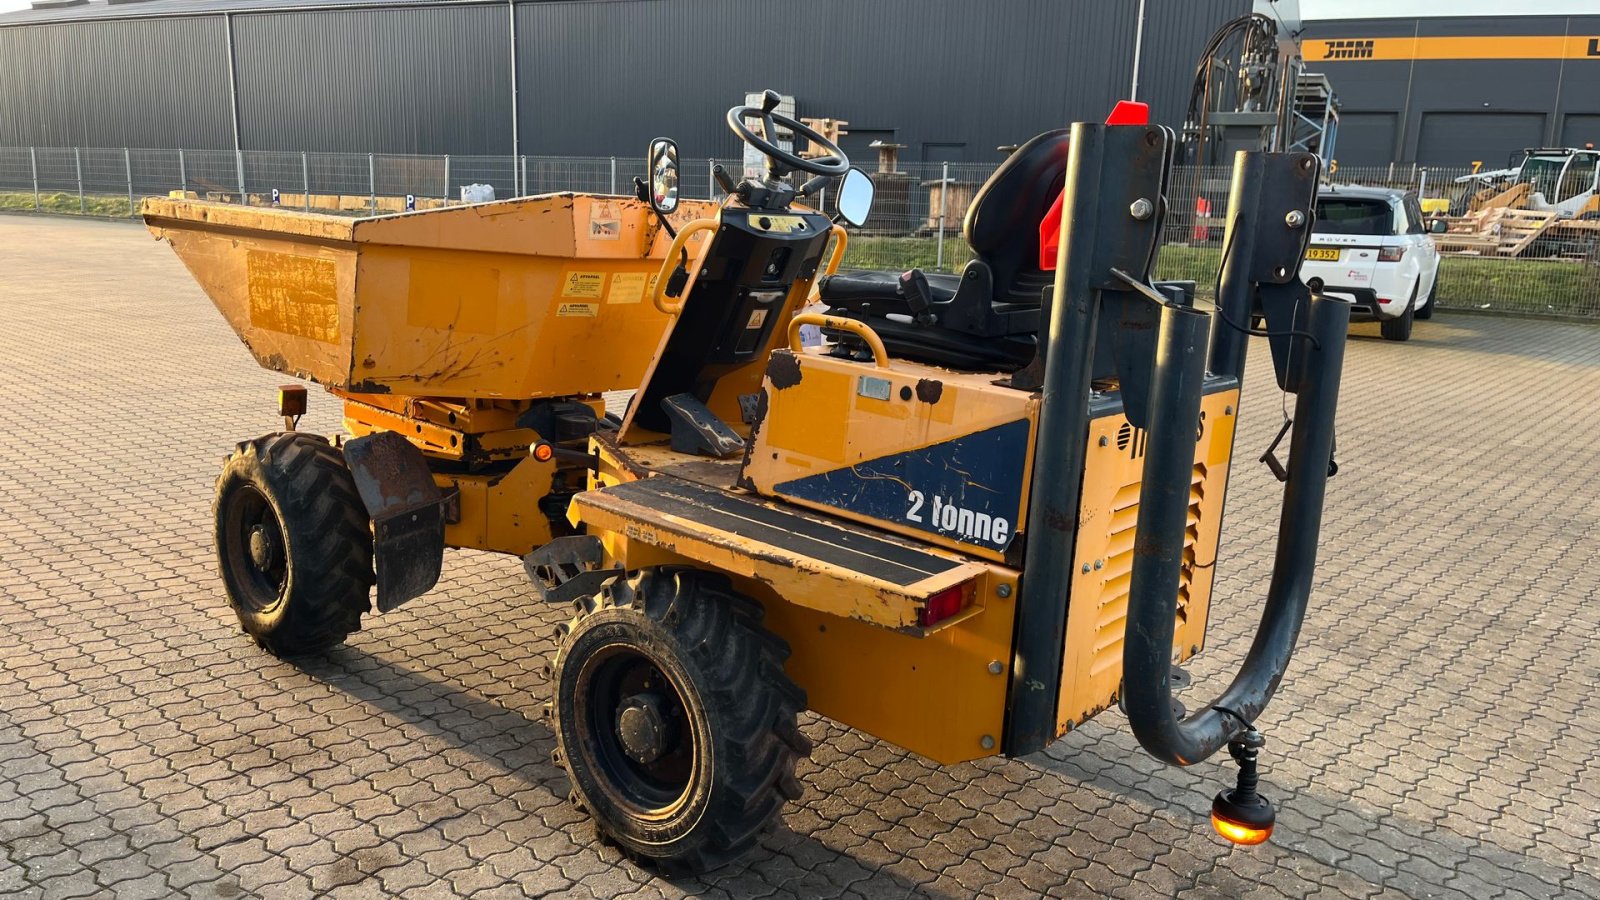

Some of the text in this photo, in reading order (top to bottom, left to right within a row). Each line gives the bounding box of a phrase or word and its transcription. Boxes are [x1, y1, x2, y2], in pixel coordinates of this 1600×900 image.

[1323, 40, 1374, 59] JMM
[1471, 161, 1482, 174] 7
[272, 188, 279, 201] P
[406, 194, 414, 208] P
[1308, 249, 1336, 259] 19 352
[906, 489, 1009, 545] 2 tonne
